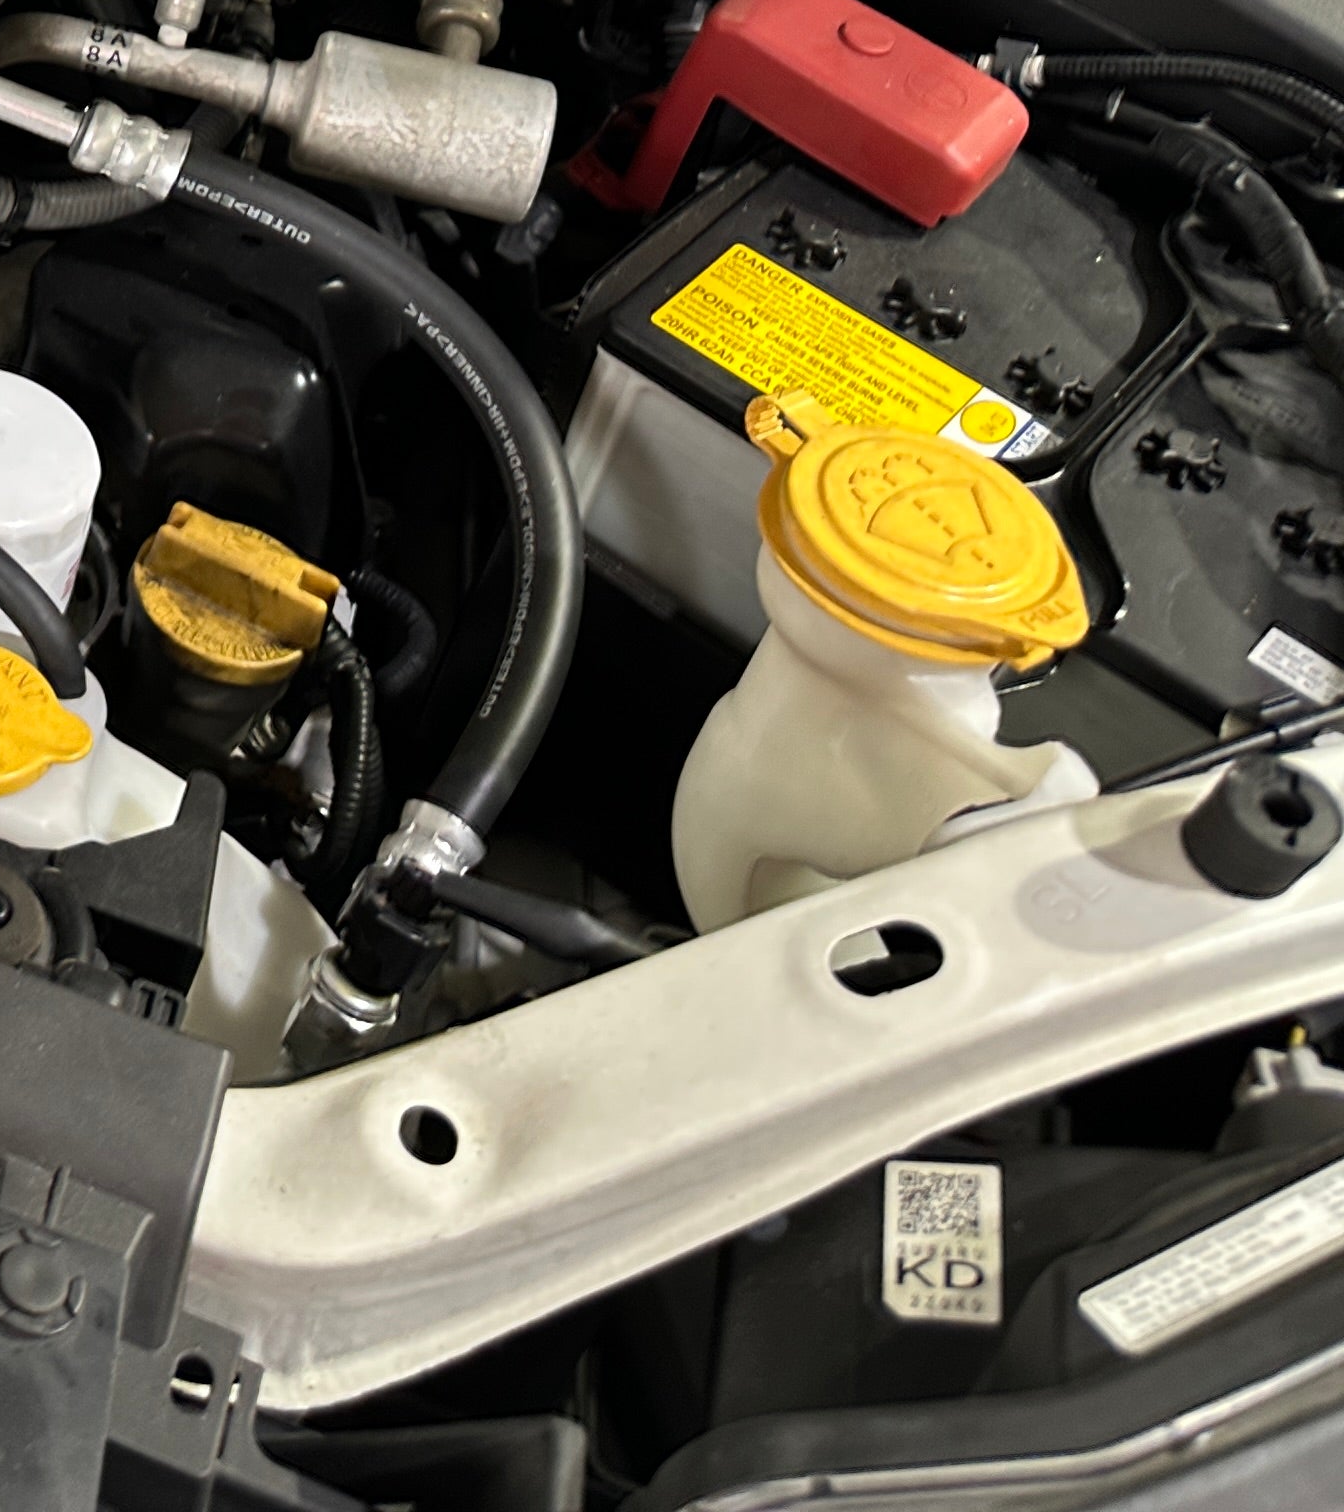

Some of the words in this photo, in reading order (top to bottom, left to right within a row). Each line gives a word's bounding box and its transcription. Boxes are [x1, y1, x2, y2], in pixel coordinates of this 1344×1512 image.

[732, 249, 804, 294] DANGER
[804, 291, 862, 328] EXPLOSIVE
[860, 324, 898, 349] GASES
[658, 313, 700, 341] 20HR
[696, 336, 737, 364] 62Ah
[737, 361, 774, 387] CCA
[689, 284, 760, 330] POISON
[763, 330, 807, 358] CAUSES
[805, 355, 848, 383] SEVERE
[845, 379, 885, 406] BURNS
[716, 333, 747, 354] KEEP
[744, 350, 769, 367] OUT
[766, 363, 784, 376] OF
[817, 395, 836, 409] OF
[749, 306, 779, 326] KEEP
[777, 322, 806, 341] VENT
[804, 338, 834, 358] CAPS
[833, 356, 865, 377] TIGHT
[862, 373, 889, 392] AND
[885, 388, 922, 412] LEVEL
[896, 1255, 985, 1291] KD
